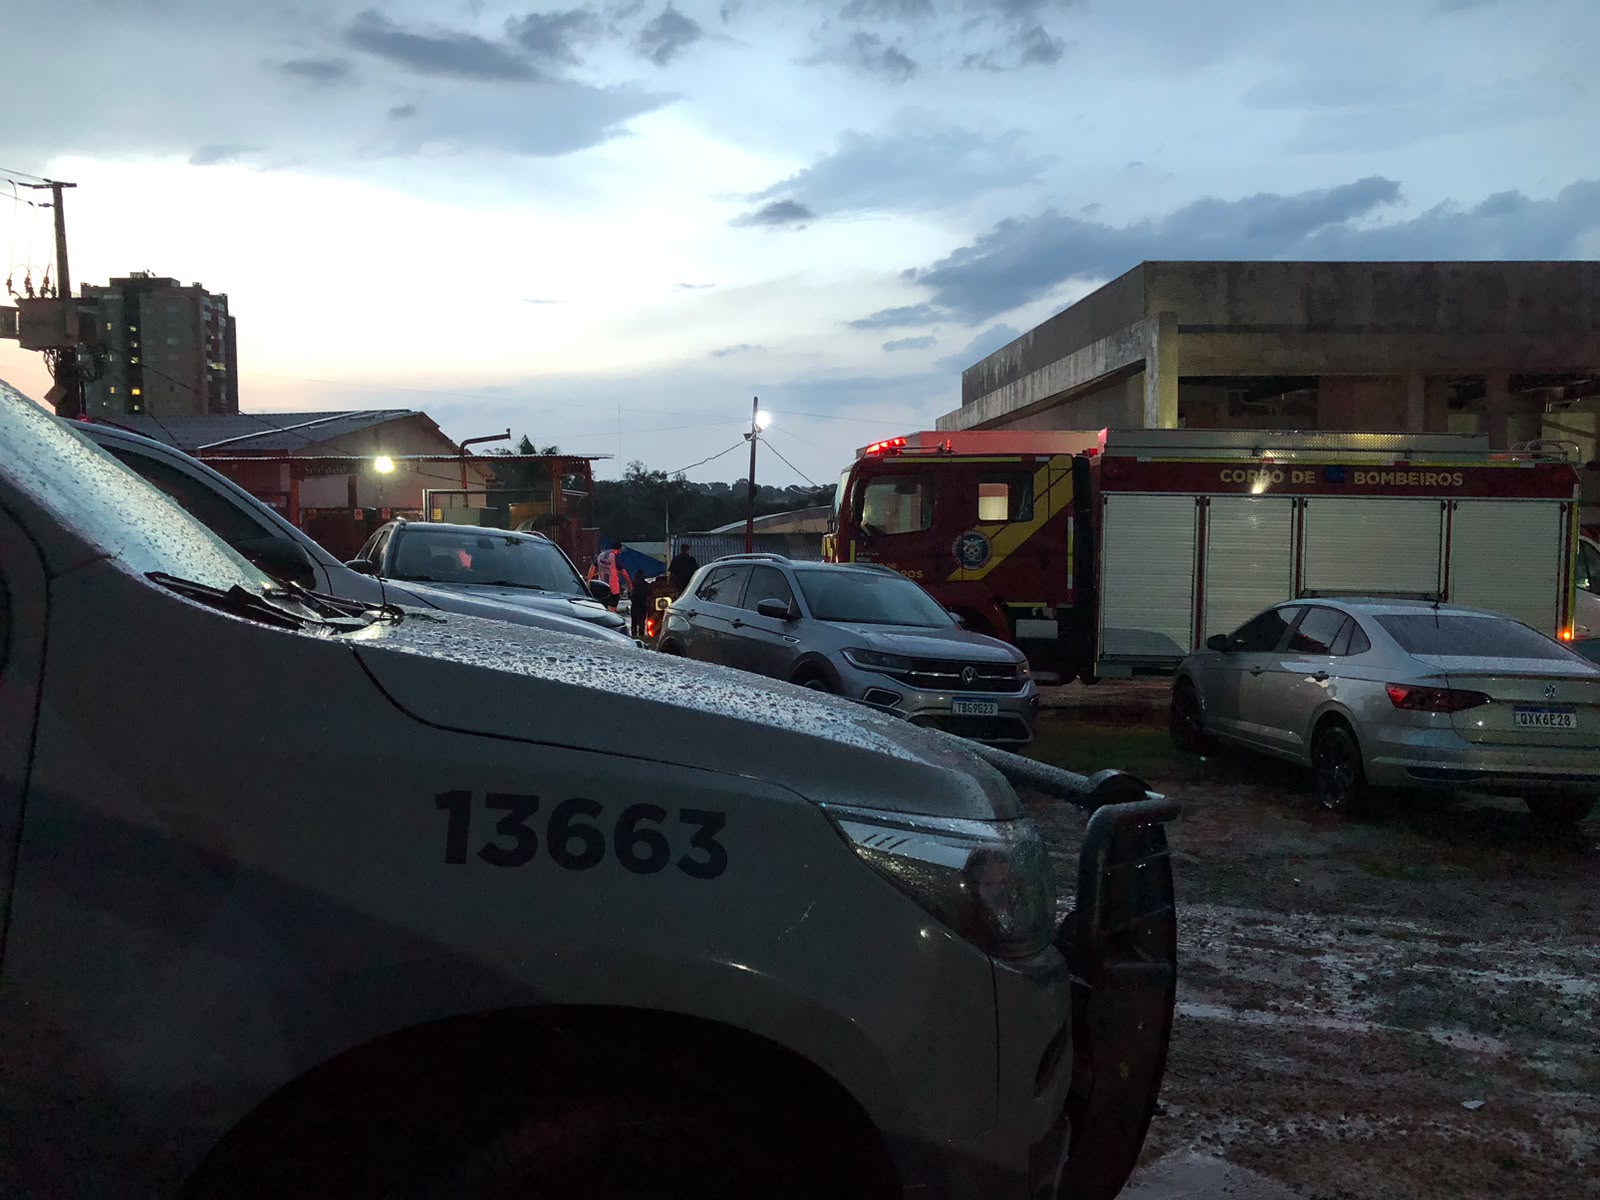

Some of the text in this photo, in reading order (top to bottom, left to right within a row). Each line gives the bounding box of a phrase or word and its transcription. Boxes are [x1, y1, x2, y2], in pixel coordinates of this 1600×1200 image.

[1220, 469, 1464, 486] CORPO DE BOMBEIROS
[1520, 713, 1571, 727] QXK6E28
[435, 790, 727, 879] 13663
